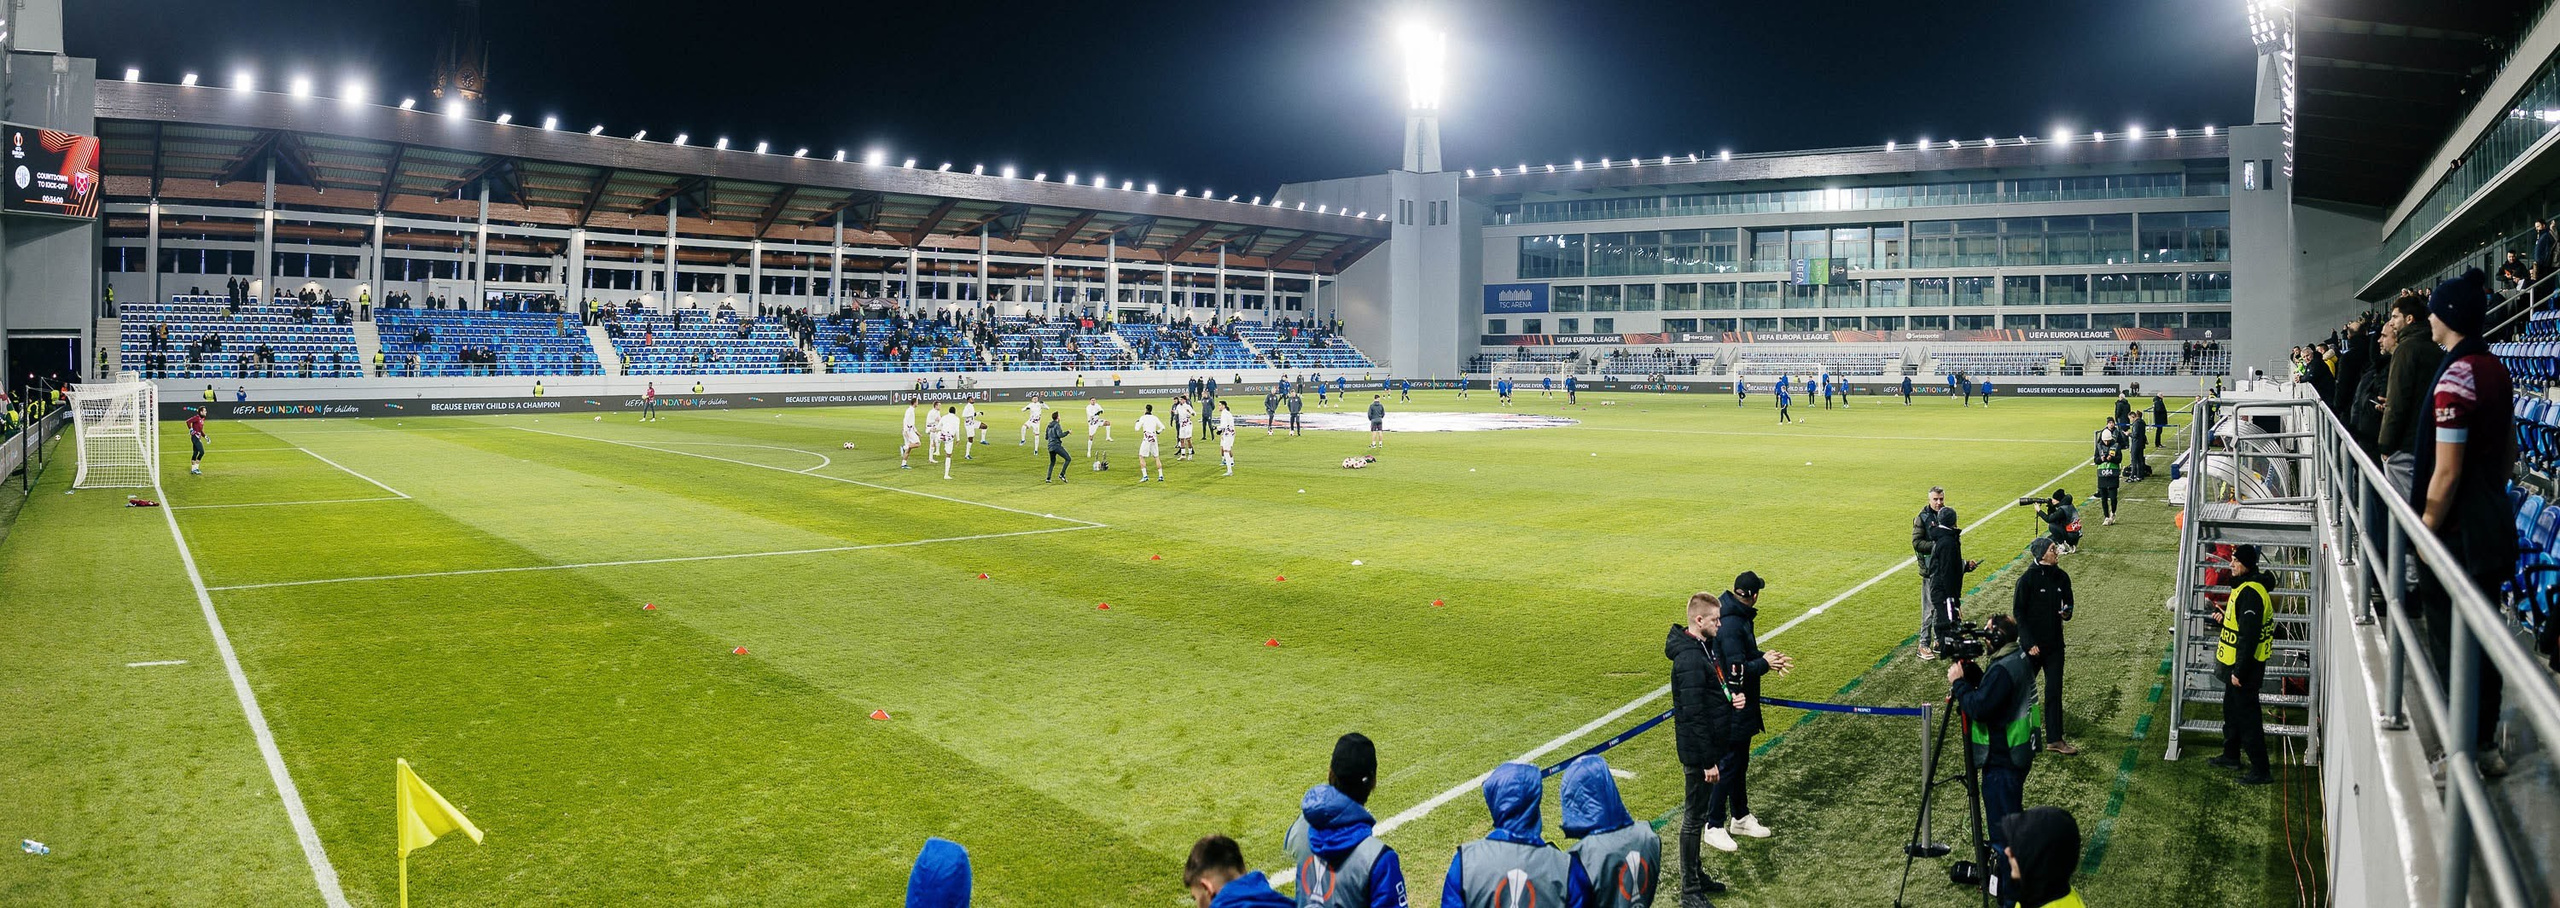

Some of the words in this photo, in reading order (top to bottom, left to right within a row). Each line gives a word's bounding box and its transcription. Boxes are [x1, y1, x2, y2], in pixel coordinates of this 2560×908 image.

[37, 172, 68, 182] COUNTDOWN
[45, 182, 68, 190] KICK-OFF
[1796, 259, 1804, 284] UEFA
[2029, 331, 2049, 339] UEFA
[2050, 331, 2079, 339] EUROPA
[2080, 331, 2110, 339] LEAGUE
[901, 393, 922, 401] UEFA
[923, 392, 952, 400] EUROPA
[953, 391, 981, 400] LEAGUE
[233, 406, 256, 414] UEFA
[258, 405, 321, 414] FOUNDATION
[323, 404, 333, 415] for
[334, 404, 359, 413] children
[431, 403, 462, 411] BECAUSE
[463, 402, 486, 410] EVERY
[486, 402, 507, 410] CHILD
[522, 401, 560, 409] CHAMPION
